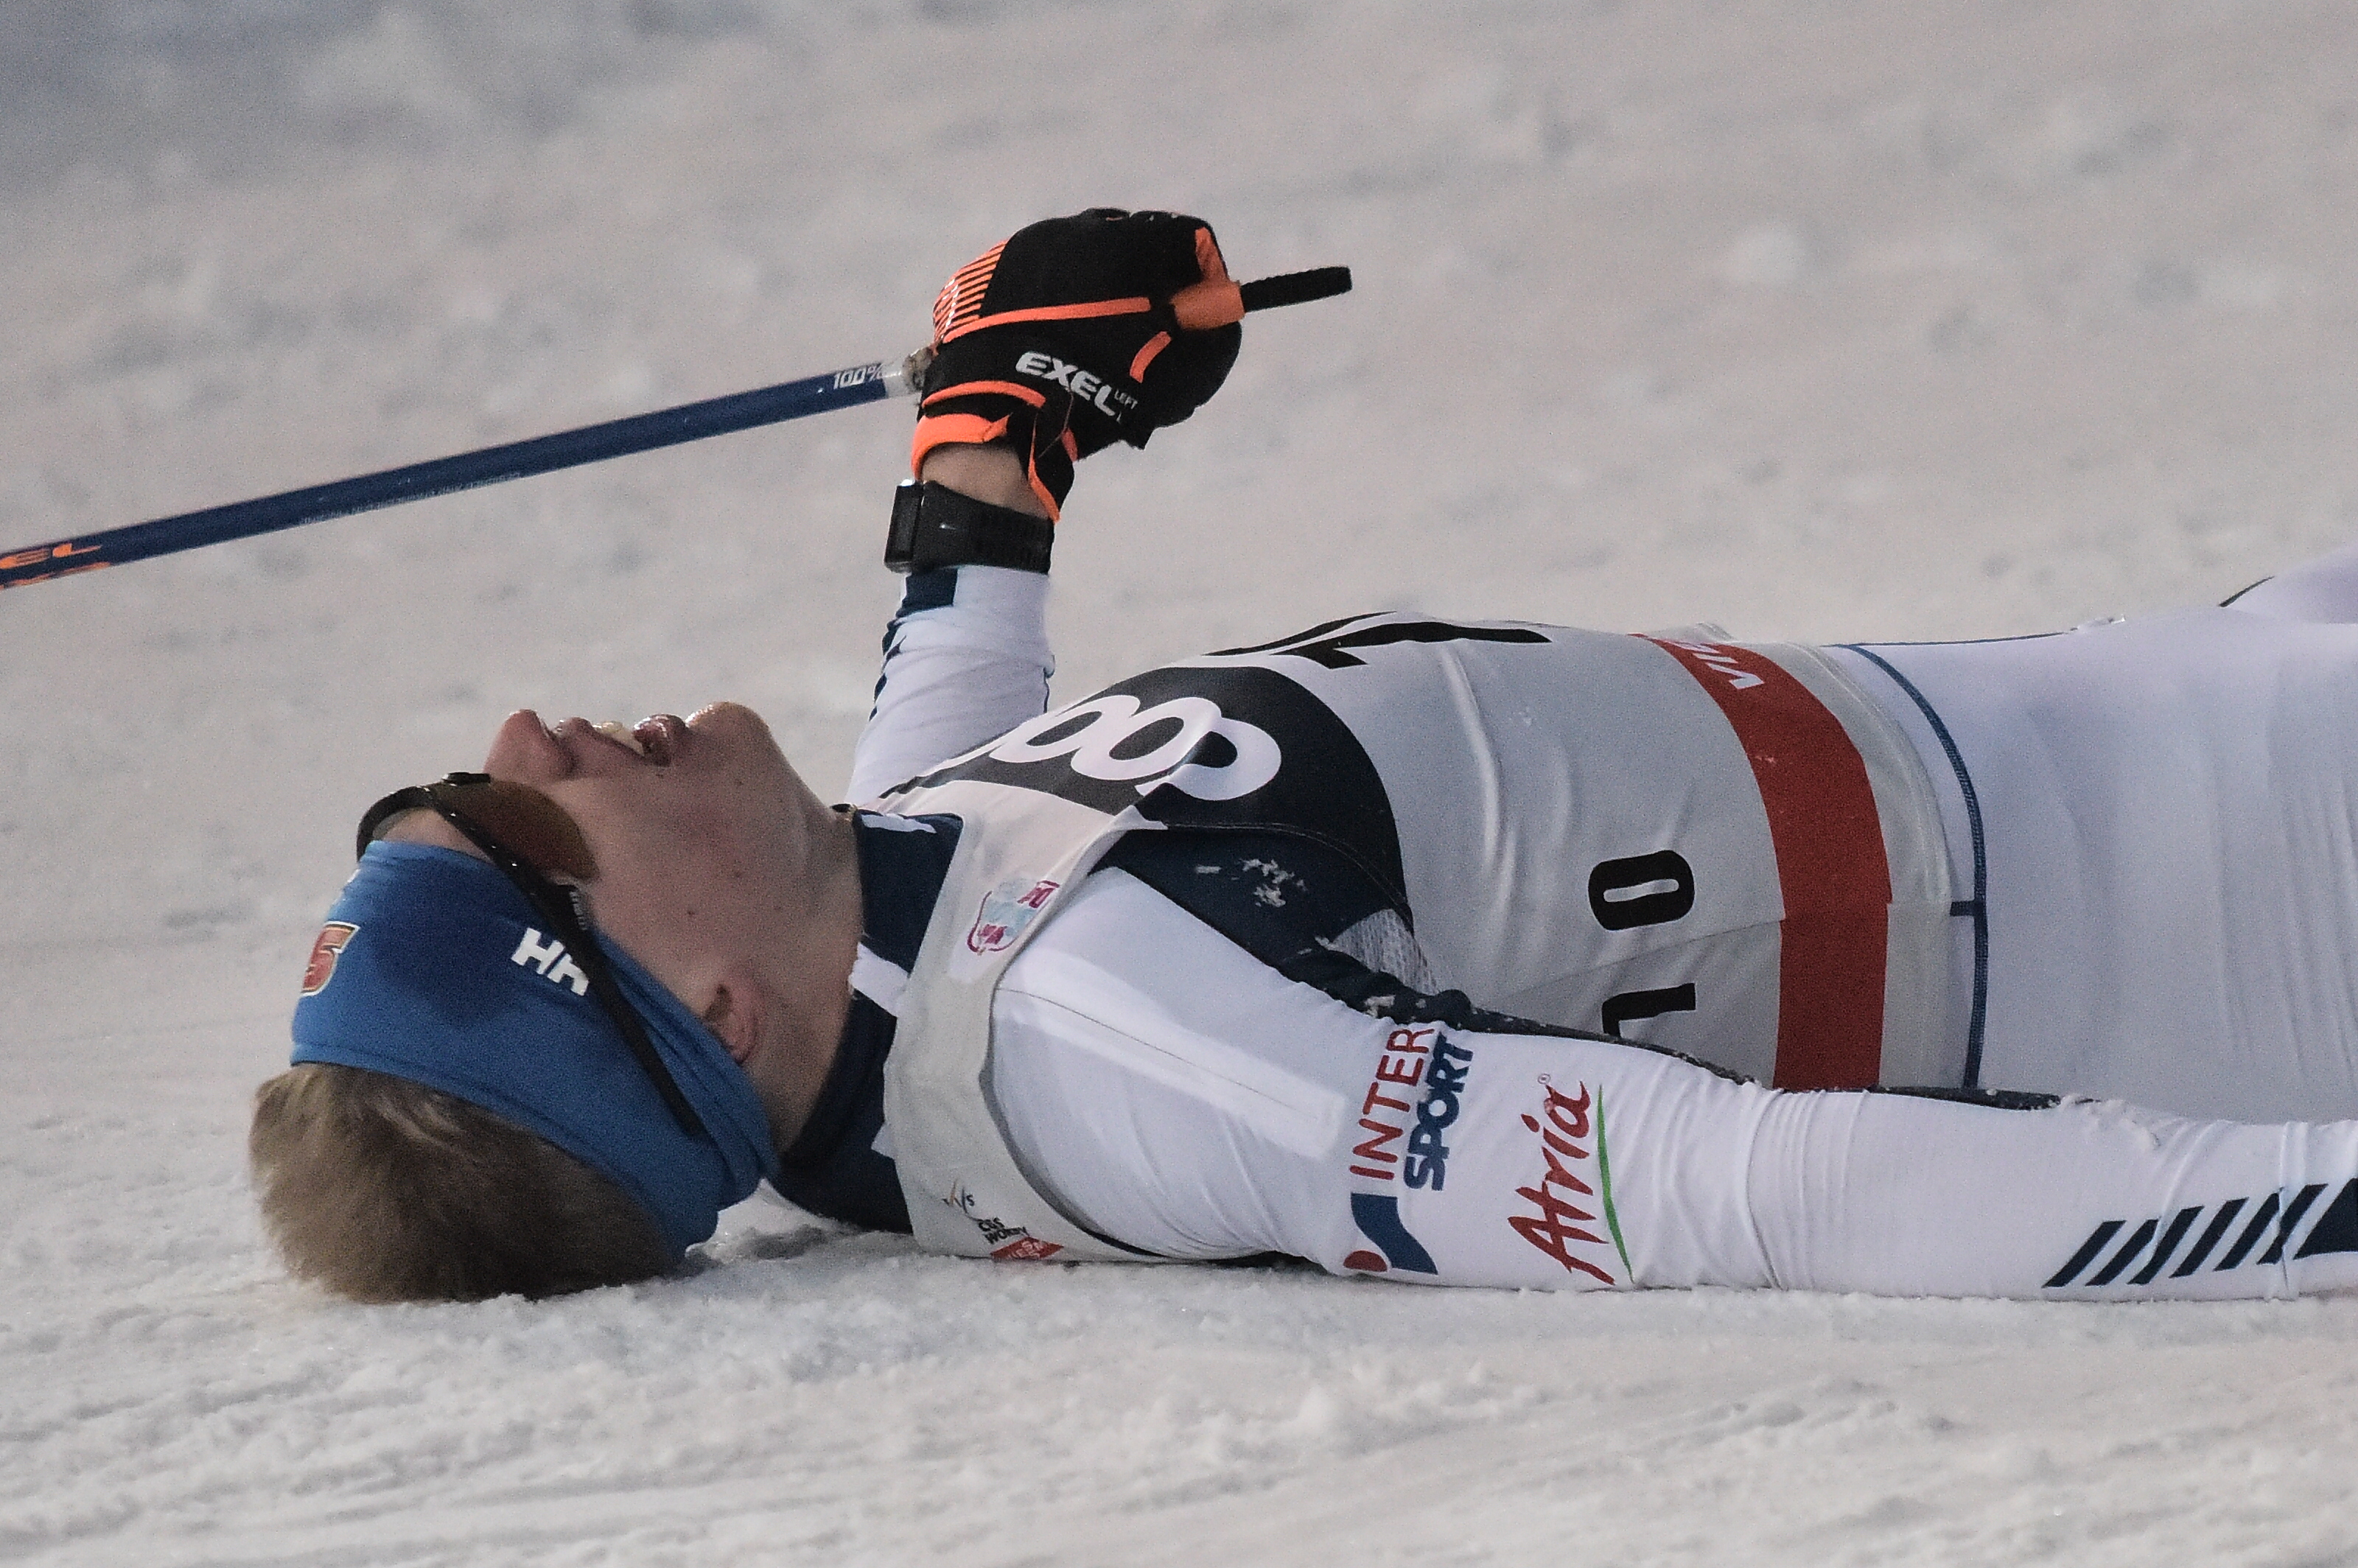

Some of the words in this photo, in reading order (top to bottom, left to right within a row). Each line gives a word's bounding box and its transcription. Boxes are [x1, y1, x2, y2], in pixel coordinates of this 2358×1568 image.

[833, 363, 884, 390] 100%
[1015, 351, 1116, 417] EXEL
[1114, 388, 1139, 410] LEFT
[1651, 640, 1765, 690] VI
[1587, 850, 1696, 1036] 10
[1349, 1028, 1435, 1180] INTER
[1403, 1032, 1474, 1191] SPORT
